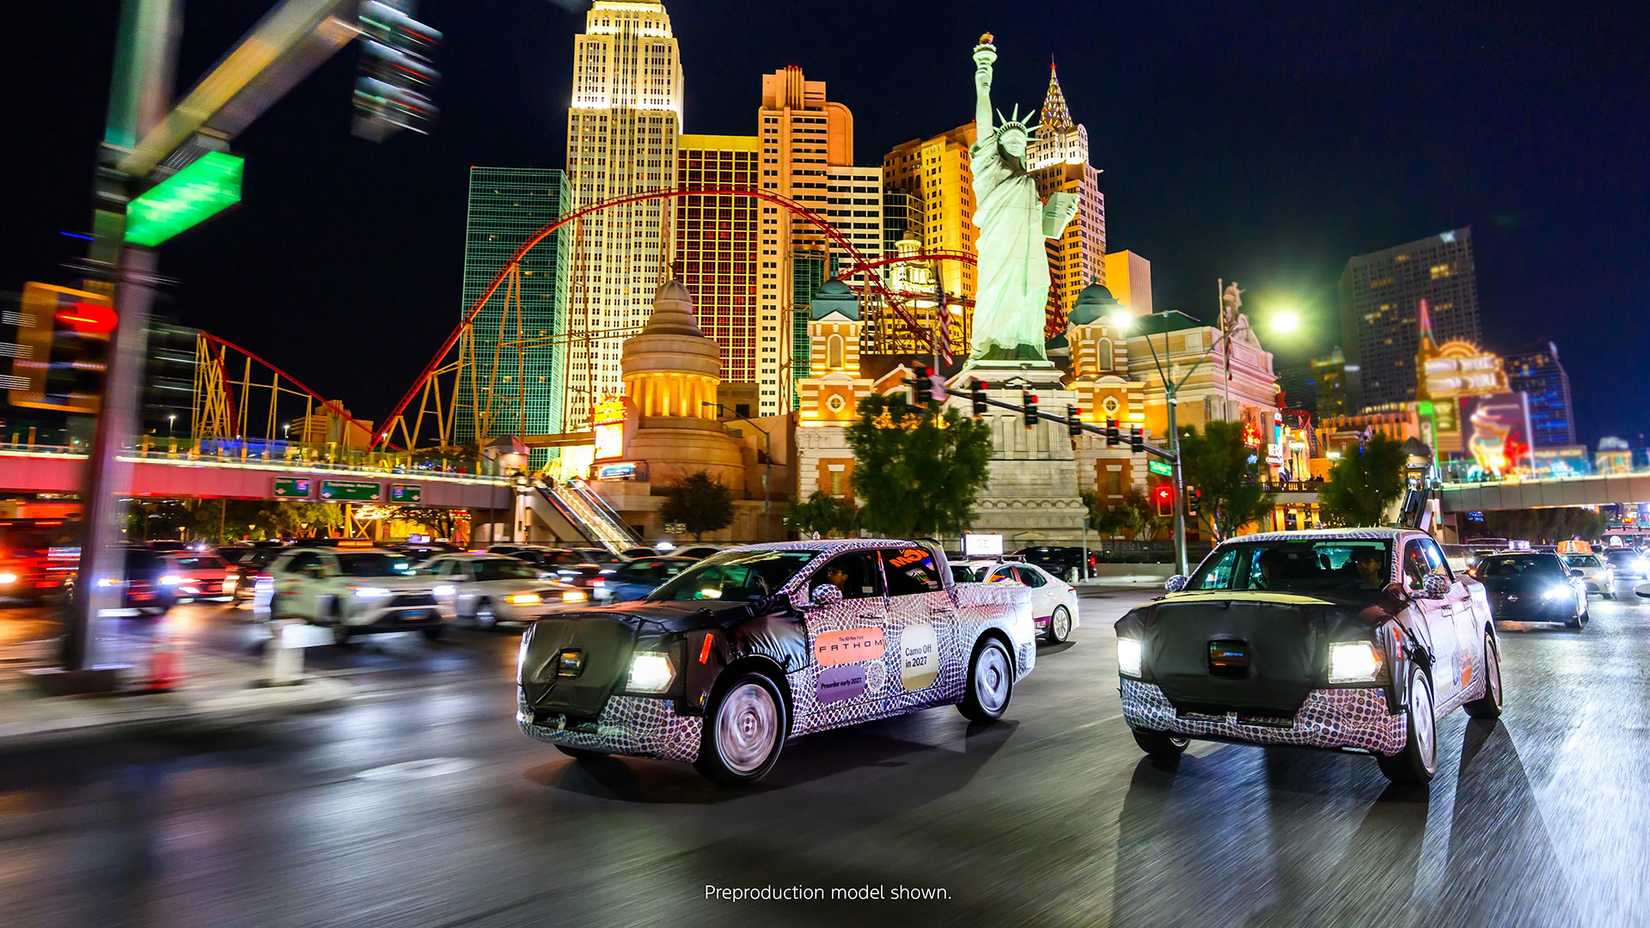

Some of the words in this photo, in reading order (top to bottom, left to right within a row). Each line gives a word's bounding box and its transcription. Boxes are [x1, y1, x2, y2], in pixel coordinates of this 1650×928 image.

[819, 639, 883, 653] FATHOM
[905, 647, 922, 657] Camo
[922, 644, 932, 654] Off
[905, 658, 912, 668] in
[912, 656, 928, 667] 2027
